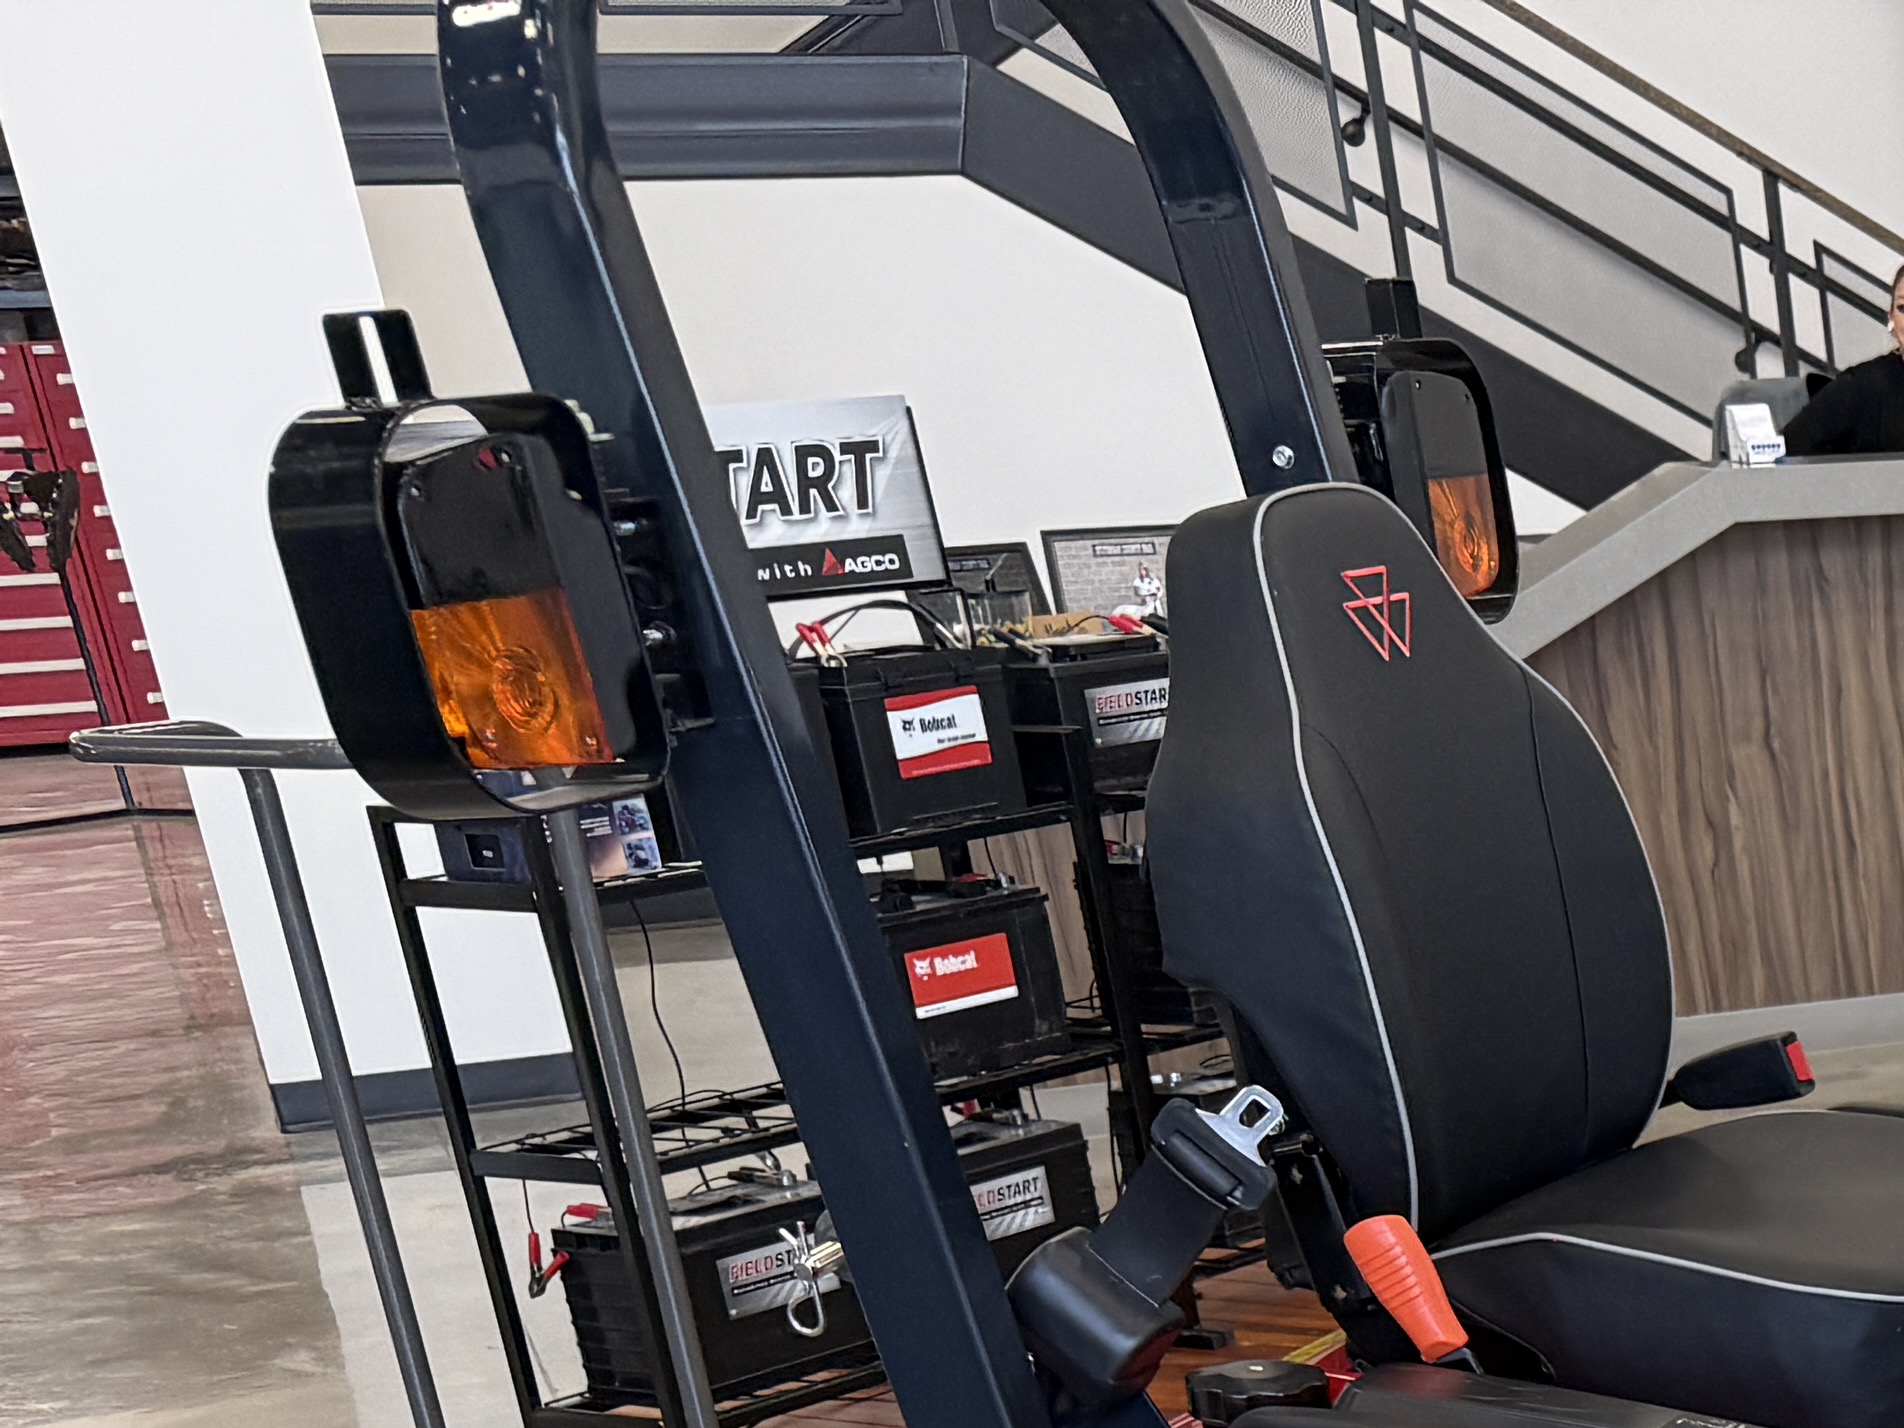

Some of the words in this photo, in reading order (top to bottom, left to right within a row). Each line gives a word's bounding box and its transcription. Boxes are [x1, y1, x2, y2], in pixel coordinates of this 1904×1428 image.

[716, 438, 884, 521] TART
[844, 553, 900, 574] AGCO
[1096, 686, 1167, 712] FIELDSTAR
[919, 714, 958, 733] Bobcat
[933, 950, 978, 976] Bobcat
[730, 1249, 793, 1283] FIELDST
